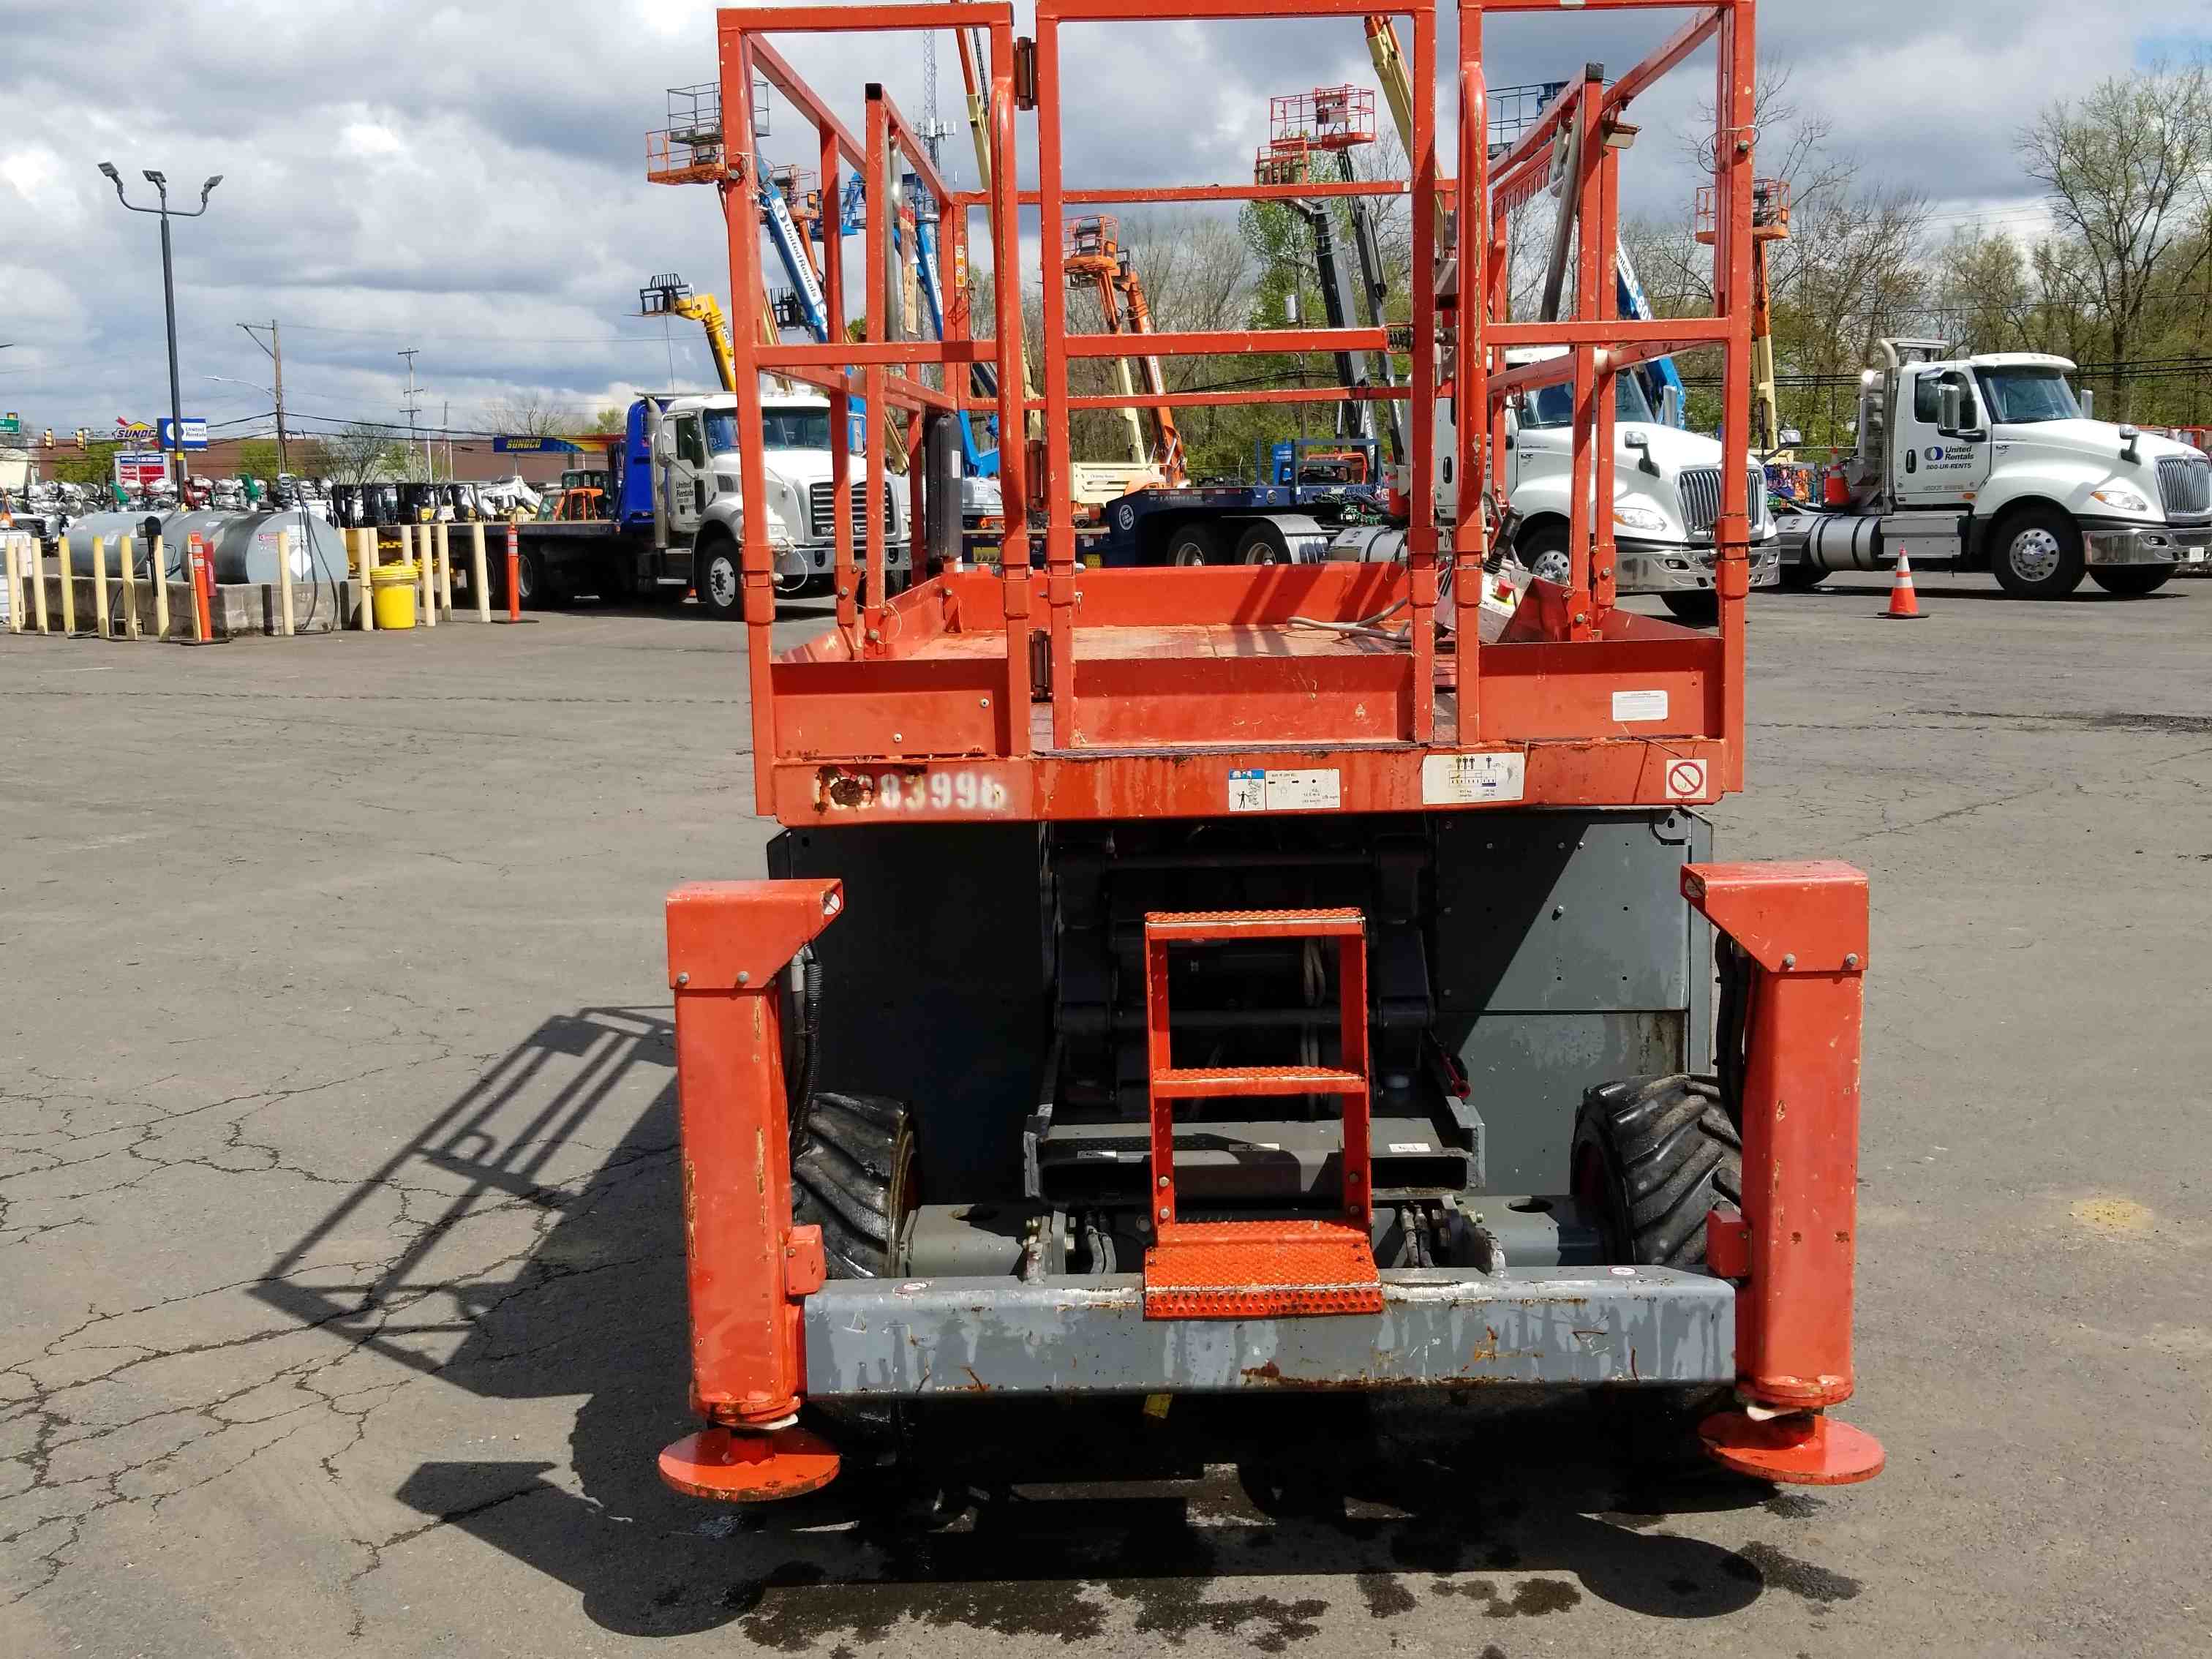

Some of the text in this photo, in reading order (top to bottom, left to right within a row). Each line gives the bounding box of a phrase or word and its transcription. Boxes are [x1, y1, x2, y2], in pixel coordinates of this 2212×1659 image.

[784, 224, 817, 297] United Rentals
[117, 429, 158, 438] SUNOC
[506, 438, 541, 449] SUNOCO
[1945, 445, 1973, 453] United
[1944, 453, 1975, 461] Rentals
[1926, 462, 1973, 470] 800-UR-RENTS
[676, 480, 692, 489] United
[676, 489, 694, 498] Rentals
